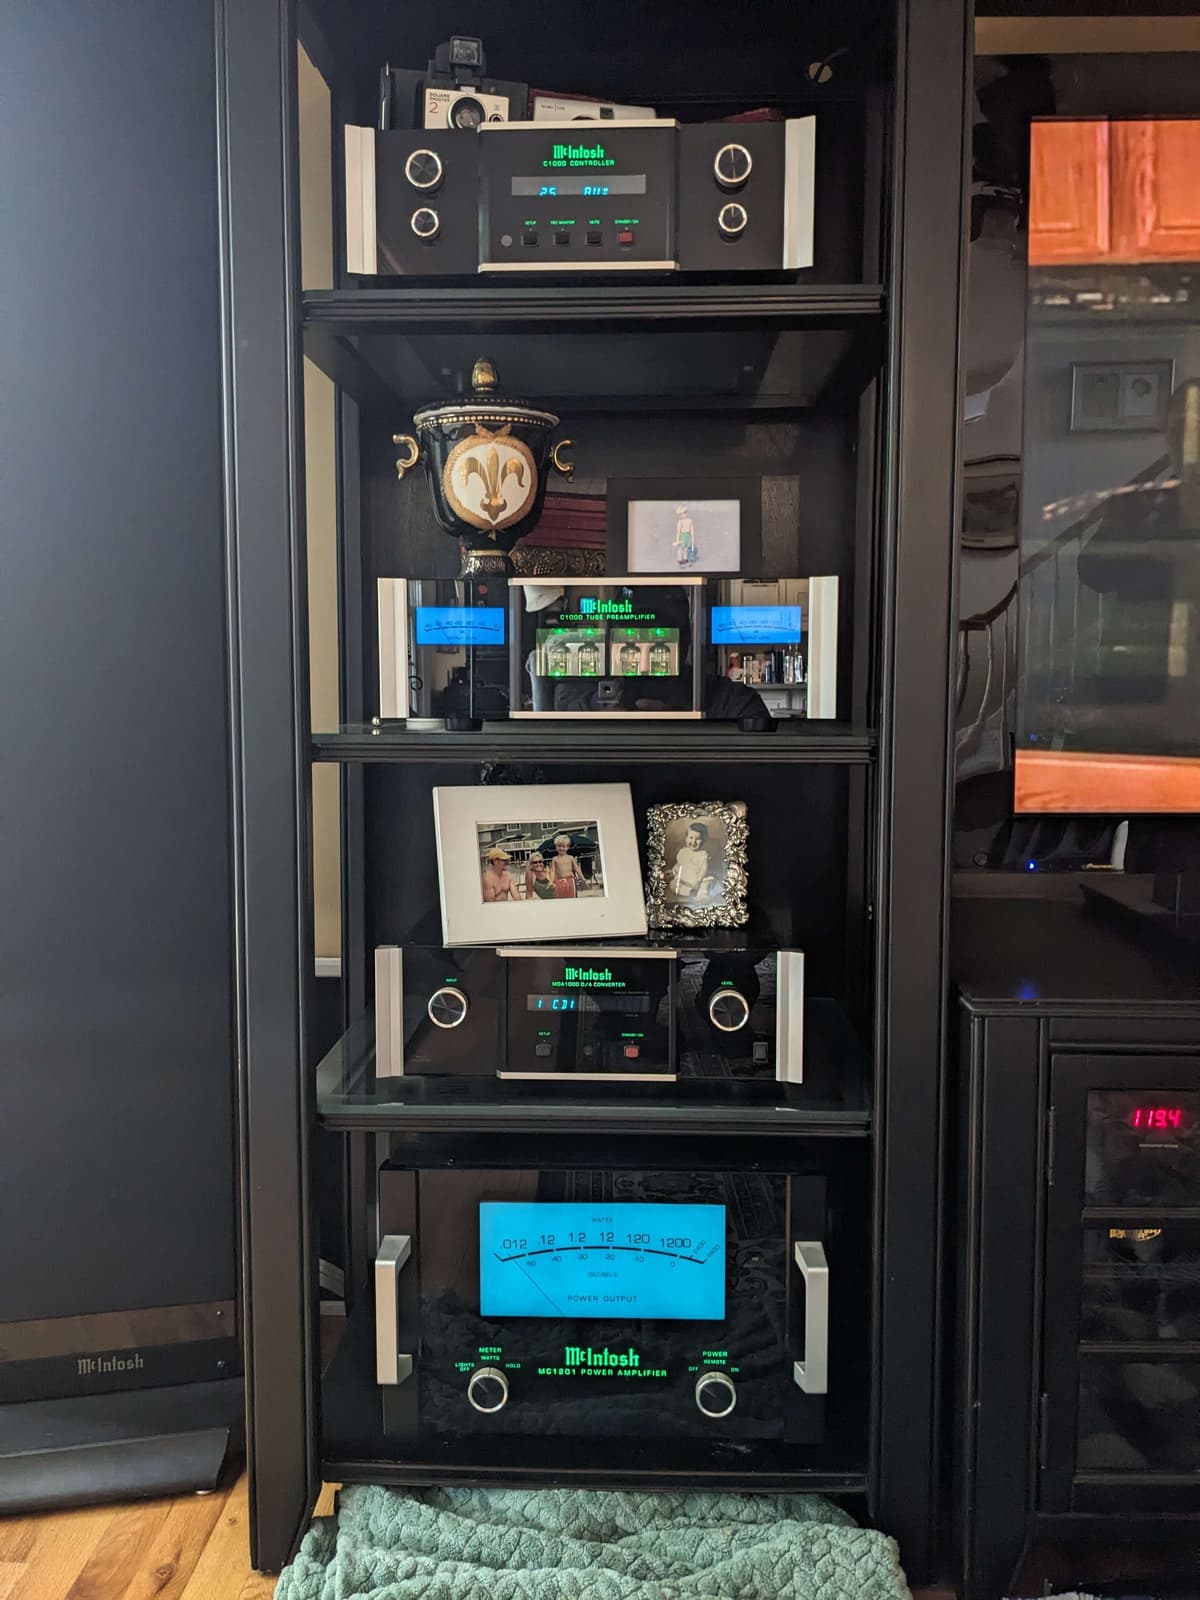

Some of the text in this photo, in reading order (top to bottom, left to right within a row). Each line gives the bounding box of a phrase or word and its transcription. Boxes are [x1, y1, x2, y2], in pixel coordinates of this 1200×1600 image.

[429, 101, 439, 114] 2
[552, 144, 605, 159] McIntosh
[569, 159, 615, 167] CONTROLLER
[580, 597, 633, 614] McIntosh
[606, 613, 656, 621] PREAMPLIFIER
[565, 967, 613, 981] McIntosh
[1133, 1109, 1181, 1128] 1194
[568, 1232, 586, 1243] 1.2
[600, 1231, 615, 1243] 12
[626, 1233, 651, 1245] 120
[660, 1237, 692, 1249] 1200
[567, 1295, 637, 1303] POWER OUTPUT
[565, 1346, 640, 1367] McIntosh
[702, 1350, 728, 1358] POWER
[78, 1353, 144, 1375] McIntosh
[538, 1367, 667, 1377] MC1201 POWER AMPLIFIER
